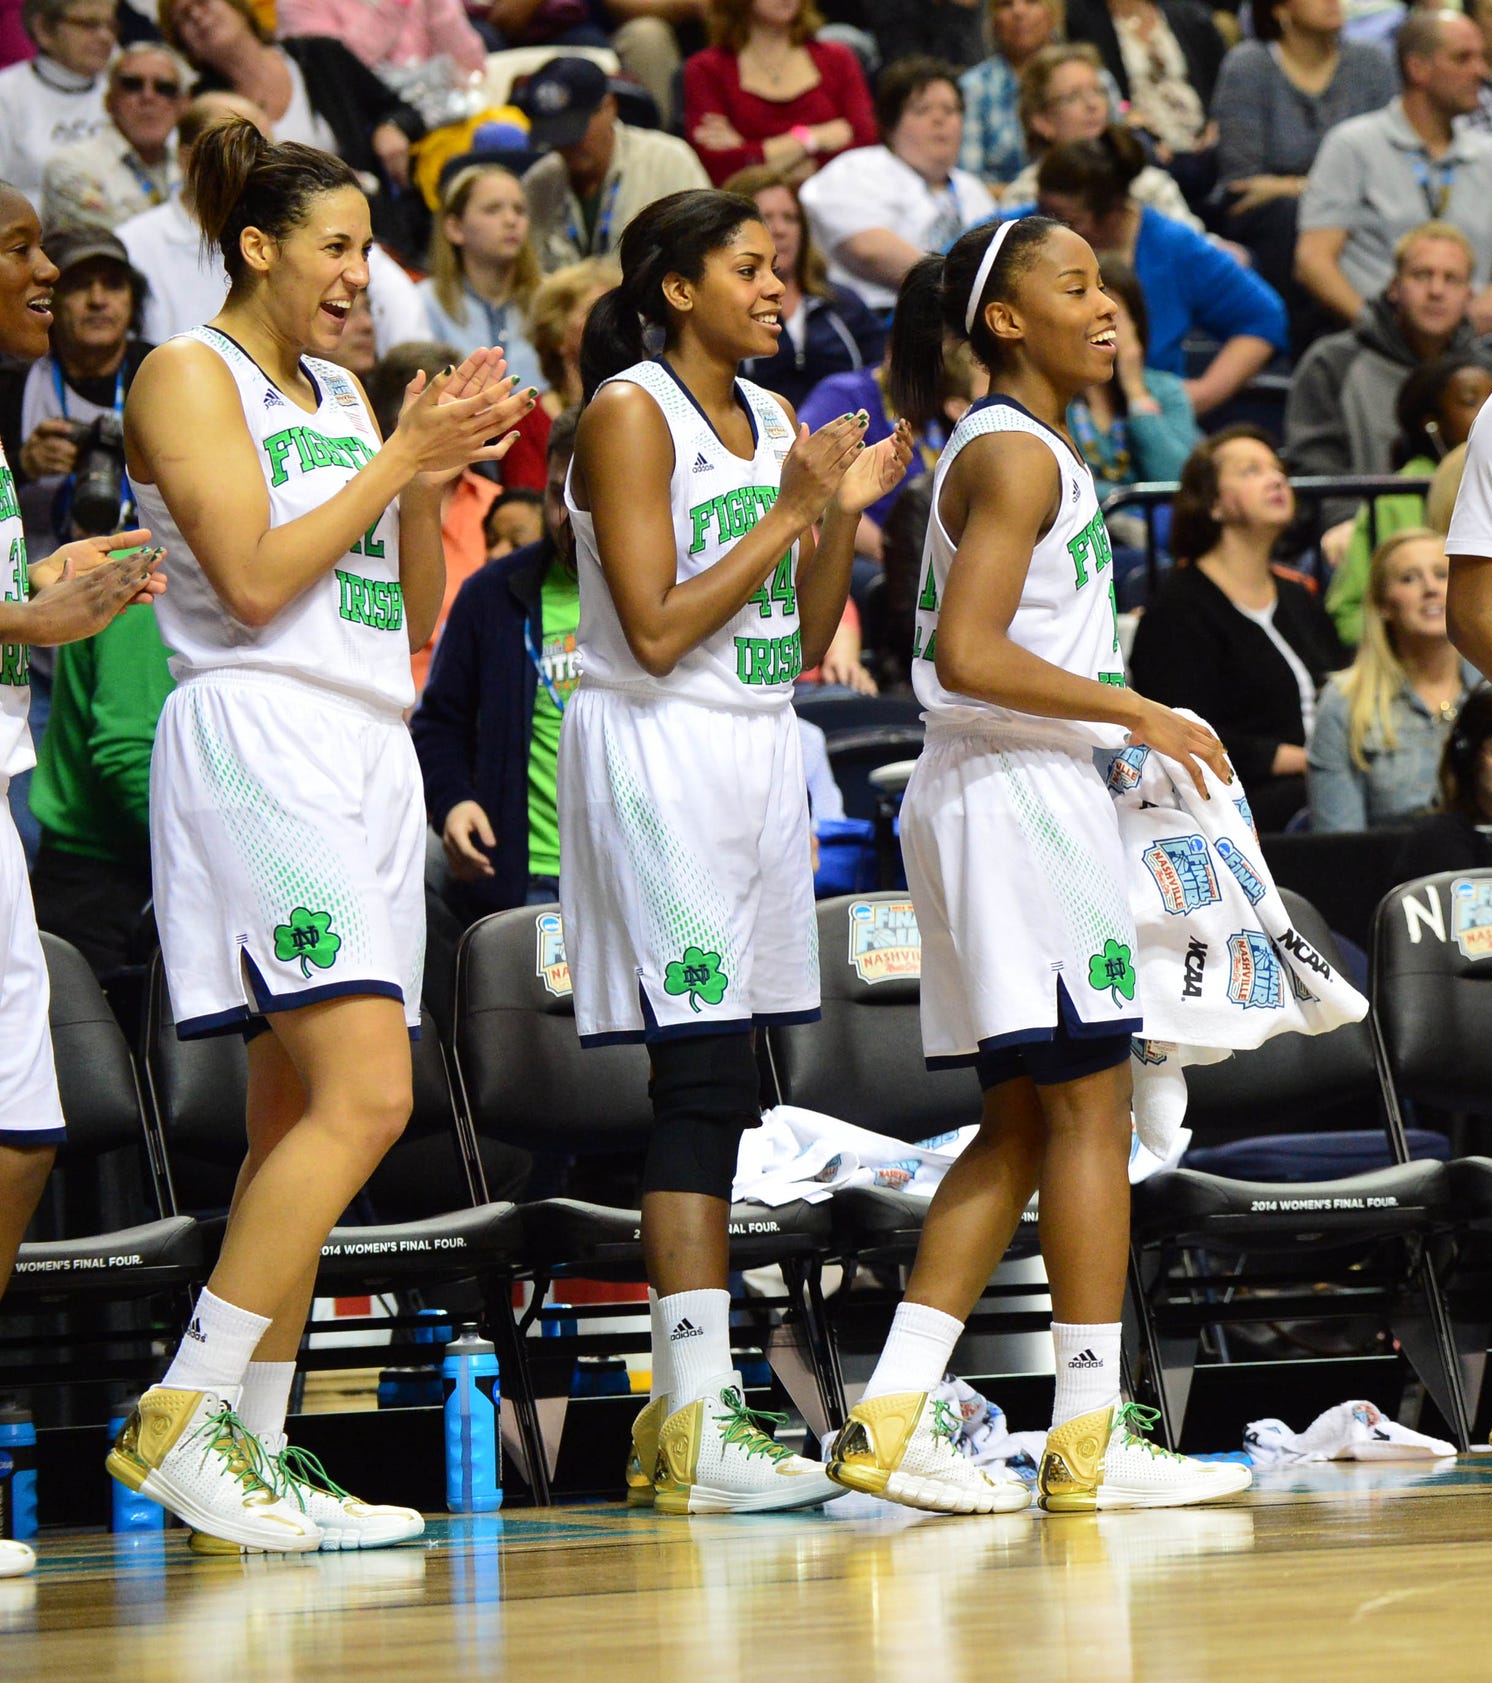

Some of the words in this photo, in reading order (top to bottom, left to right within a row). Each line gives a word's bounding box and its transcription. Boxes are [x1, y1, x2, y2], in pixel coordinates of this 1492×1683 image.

[335, 569, 403, 631] IRISH
[733, 628, 803, 686] IRISH
[1153, 851, 1185, 909] NASHVILLE
[1402, 885, 1447, 943] N
[1183, 935, 1209, 998] NCAA
[1237, 940, 1252, 1001] NASHVILLE
[1277, 928, 1332, 981] NCAA
[1251, 1200, 1278, 1212] 2014
[1279, 1199, 1332, 1211] WOMEN'S
[1333, 1198, 1365, 1209] FINAL
[15, 1260, 72, 1273] WOMEN'S
[73, 1258, 106, 1270] FINAL
[320, 1245, 341, 1256] 014
[343, 1241, 398, 1255] WOMEN'S
[400, 1239, 431, 1252] FINAL
[671, 1328, 705, 1341] adidas
[1068, 1359, 1104, 1369] adidas
